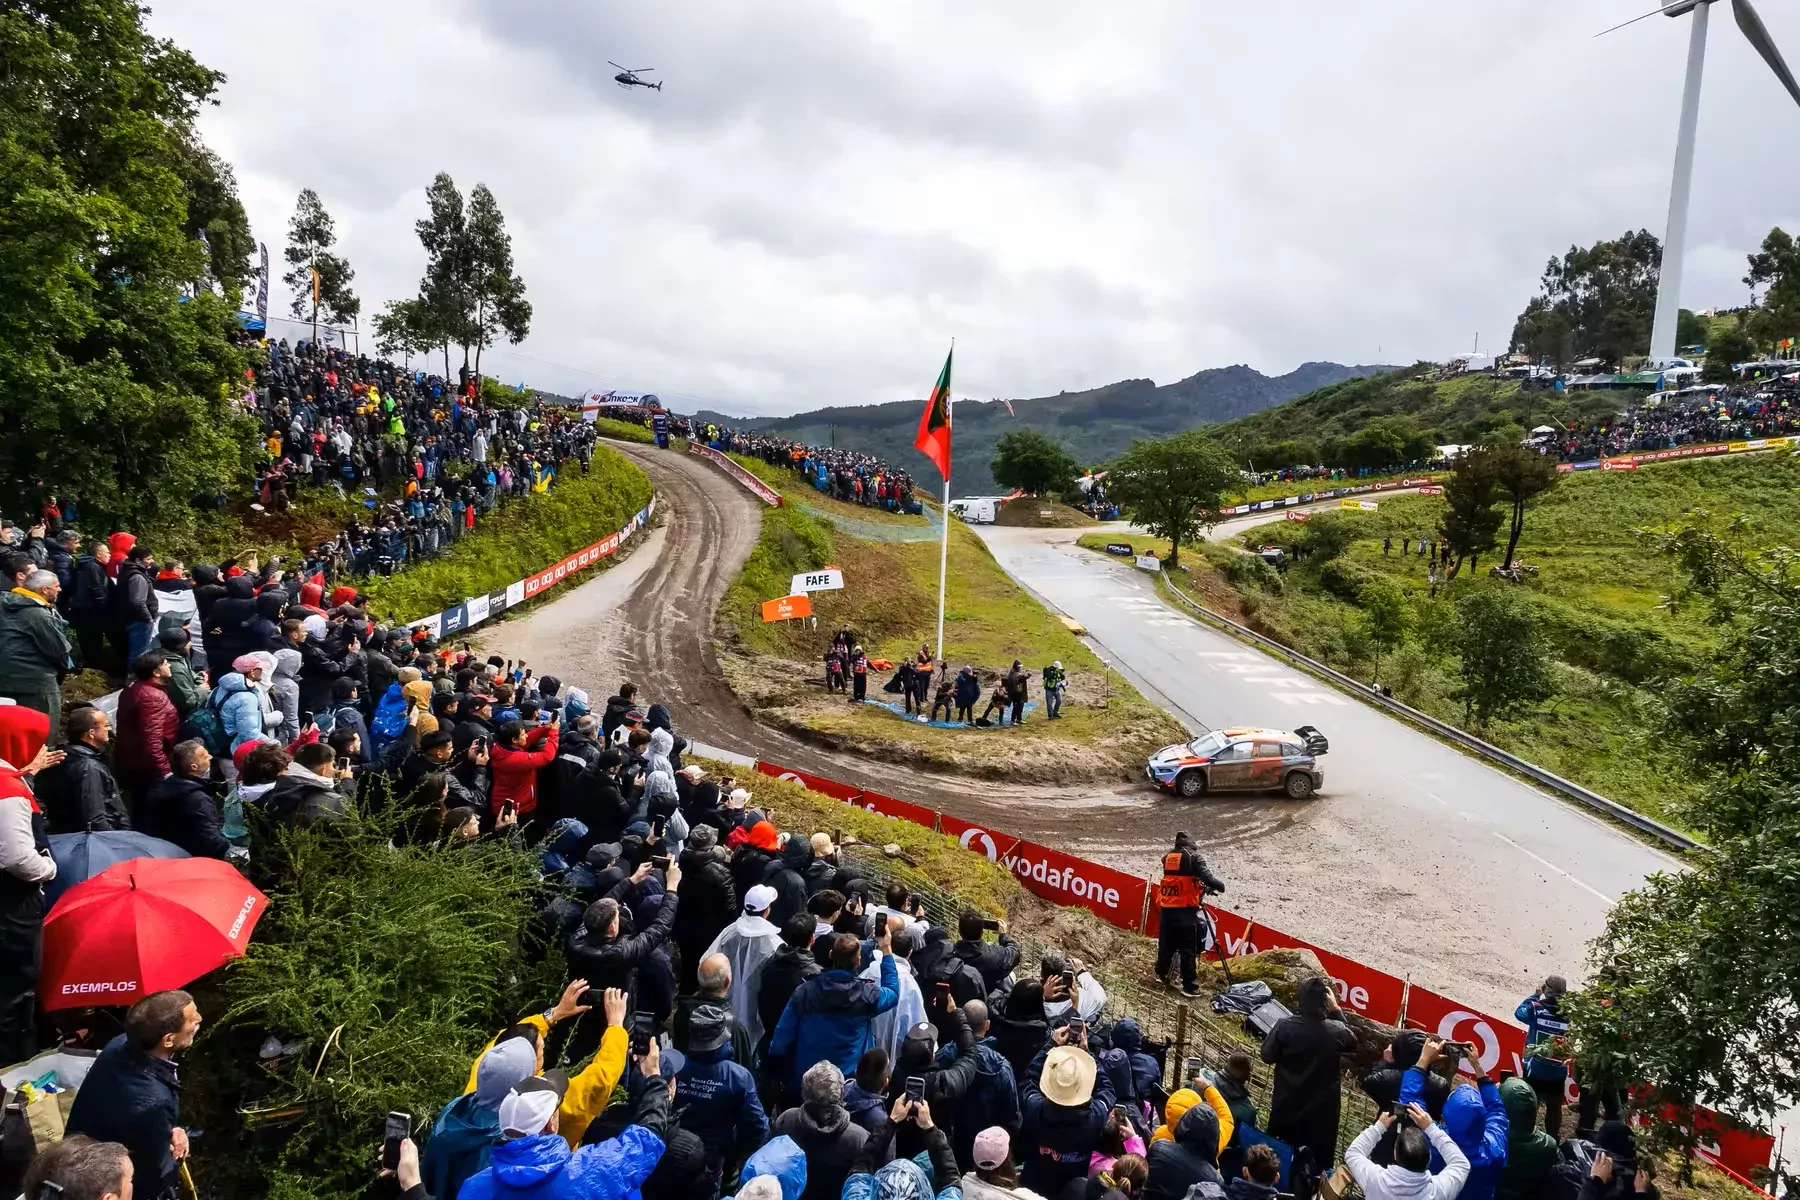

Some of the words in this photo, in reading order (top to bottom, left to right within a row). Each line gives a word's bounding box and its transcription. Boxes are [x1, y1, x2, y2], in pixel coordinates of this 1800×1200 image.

[806, 575, 829, 586] FAFE
[1005, 855, 1120, 908] vodafone
[1161, 885, 1179, 896] 028
[228, 895, 256, 939] EXEMPLOS
[62, 981, 136, 994] EXEMPLOS
